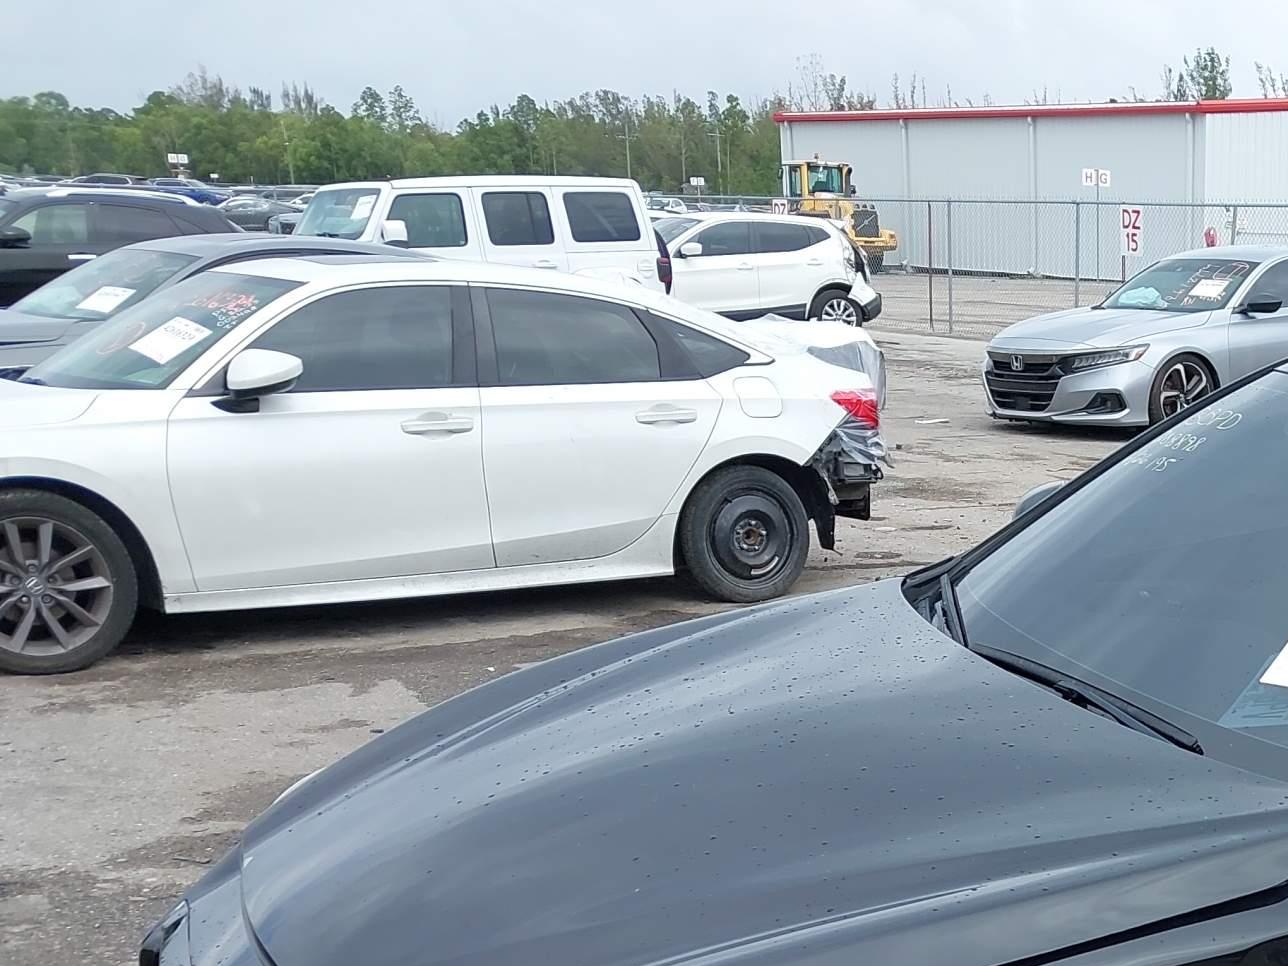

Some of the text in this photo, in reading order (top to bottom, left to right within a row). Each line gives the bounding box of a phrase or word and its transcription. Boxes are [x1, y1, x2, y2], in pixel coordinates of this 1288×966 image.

[1085, 171, 1093, 184] H
[1099, 172, 1108, 185] G
[1122, 208, 1141, 230] DZ
[1126, 232, 1139, 252] 15
